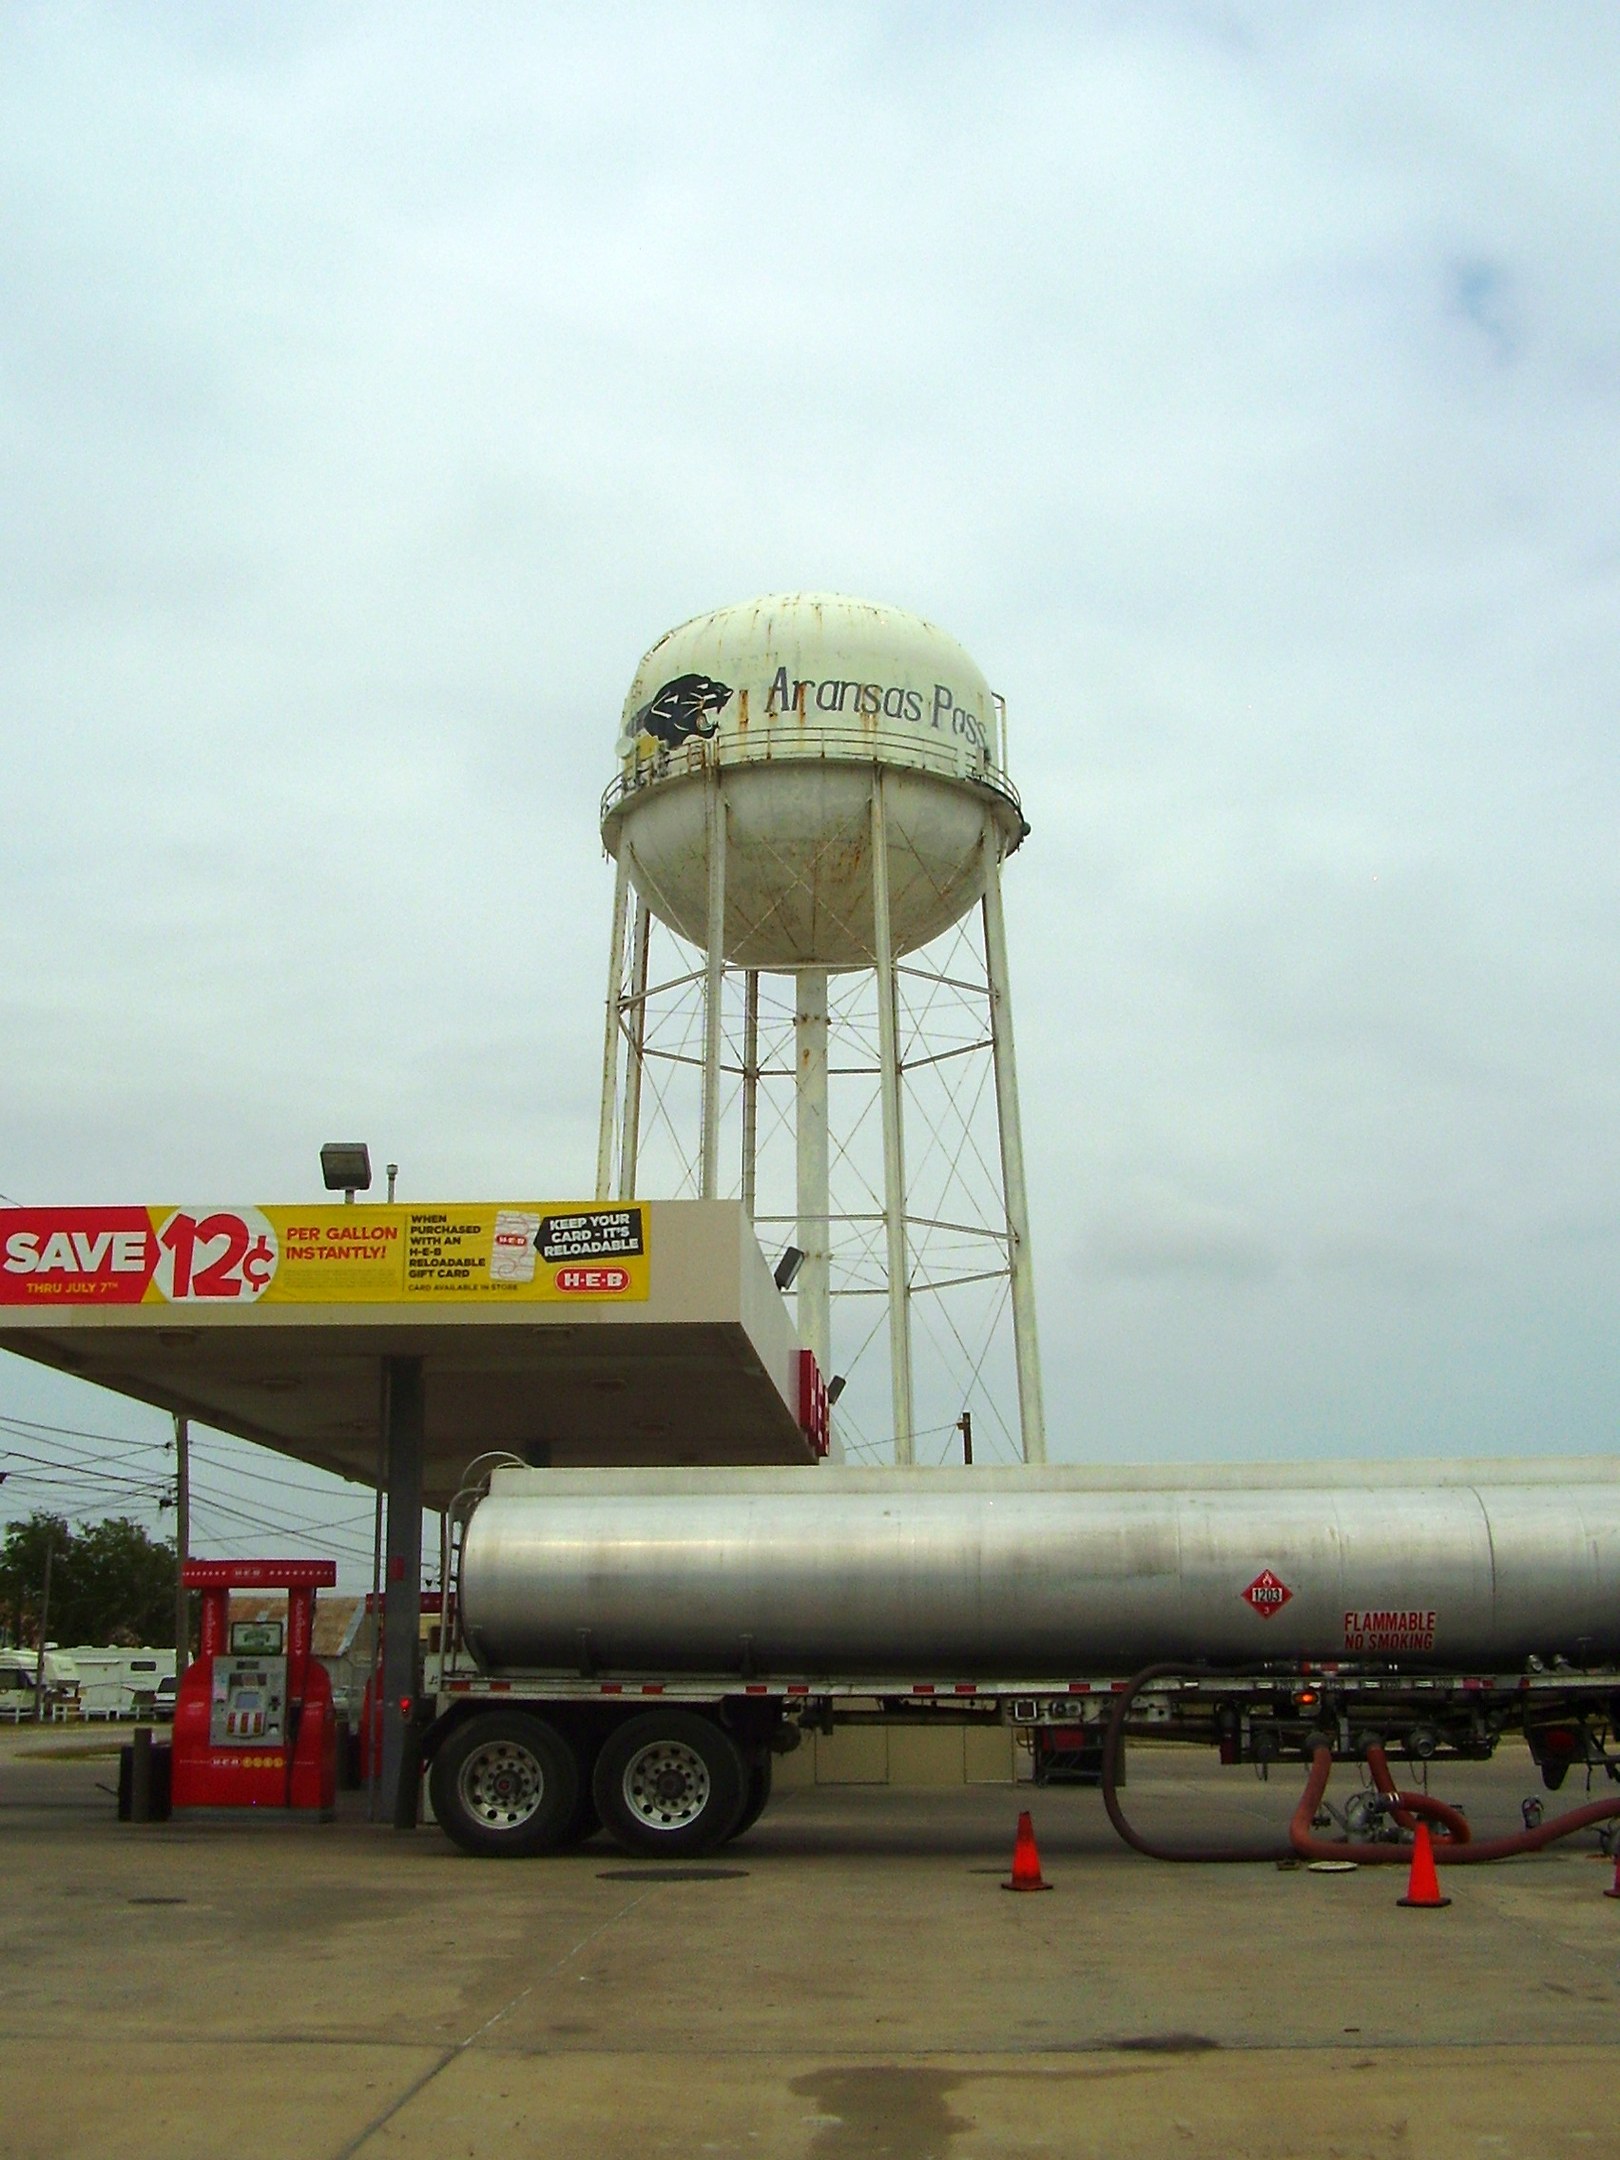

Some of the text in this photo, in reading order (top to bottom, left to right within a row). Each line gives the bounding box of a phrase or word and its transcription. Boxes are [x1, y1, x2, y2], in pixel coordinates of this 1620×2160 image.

[764, 666, 986, 749] Aransas Pass
[411, 1214, 447, 1223] WHEN
[549, 1213, 630, 1231] KEEP YOUR
[287, 1226, 398, 1240] PER GALLON
[410, 1225, 482, 1234] PURCHASED
[551, 1229, 592, 1243] CARD
[603, 1226, 630, 1239] IT'S
[410, 1236, 461, 1245] WITH AN
[544, 1238, 639, 1257] RELOADABLE
[3, 1231, 147, 1274] SAVE
[286, 1246, 386, 1260] INSTANTLY!
[409, 1247, 442, 1256] H-E-B
[409, 1258, 485, 1267] RELOADABLE
[408, 1269, 434, 1278] GIFT
[437, 1269, 470, 1278] CARD
[26, 1282, 62, 1294] THRU
[65, 1282, 96, 1294] JULY
[1254, 1588, 1280, 1602] 1203
[1344, 1611, 1436, 1632] FLAMMABLE
[1344, 1633, 1433, 1650] NO SMOKING
